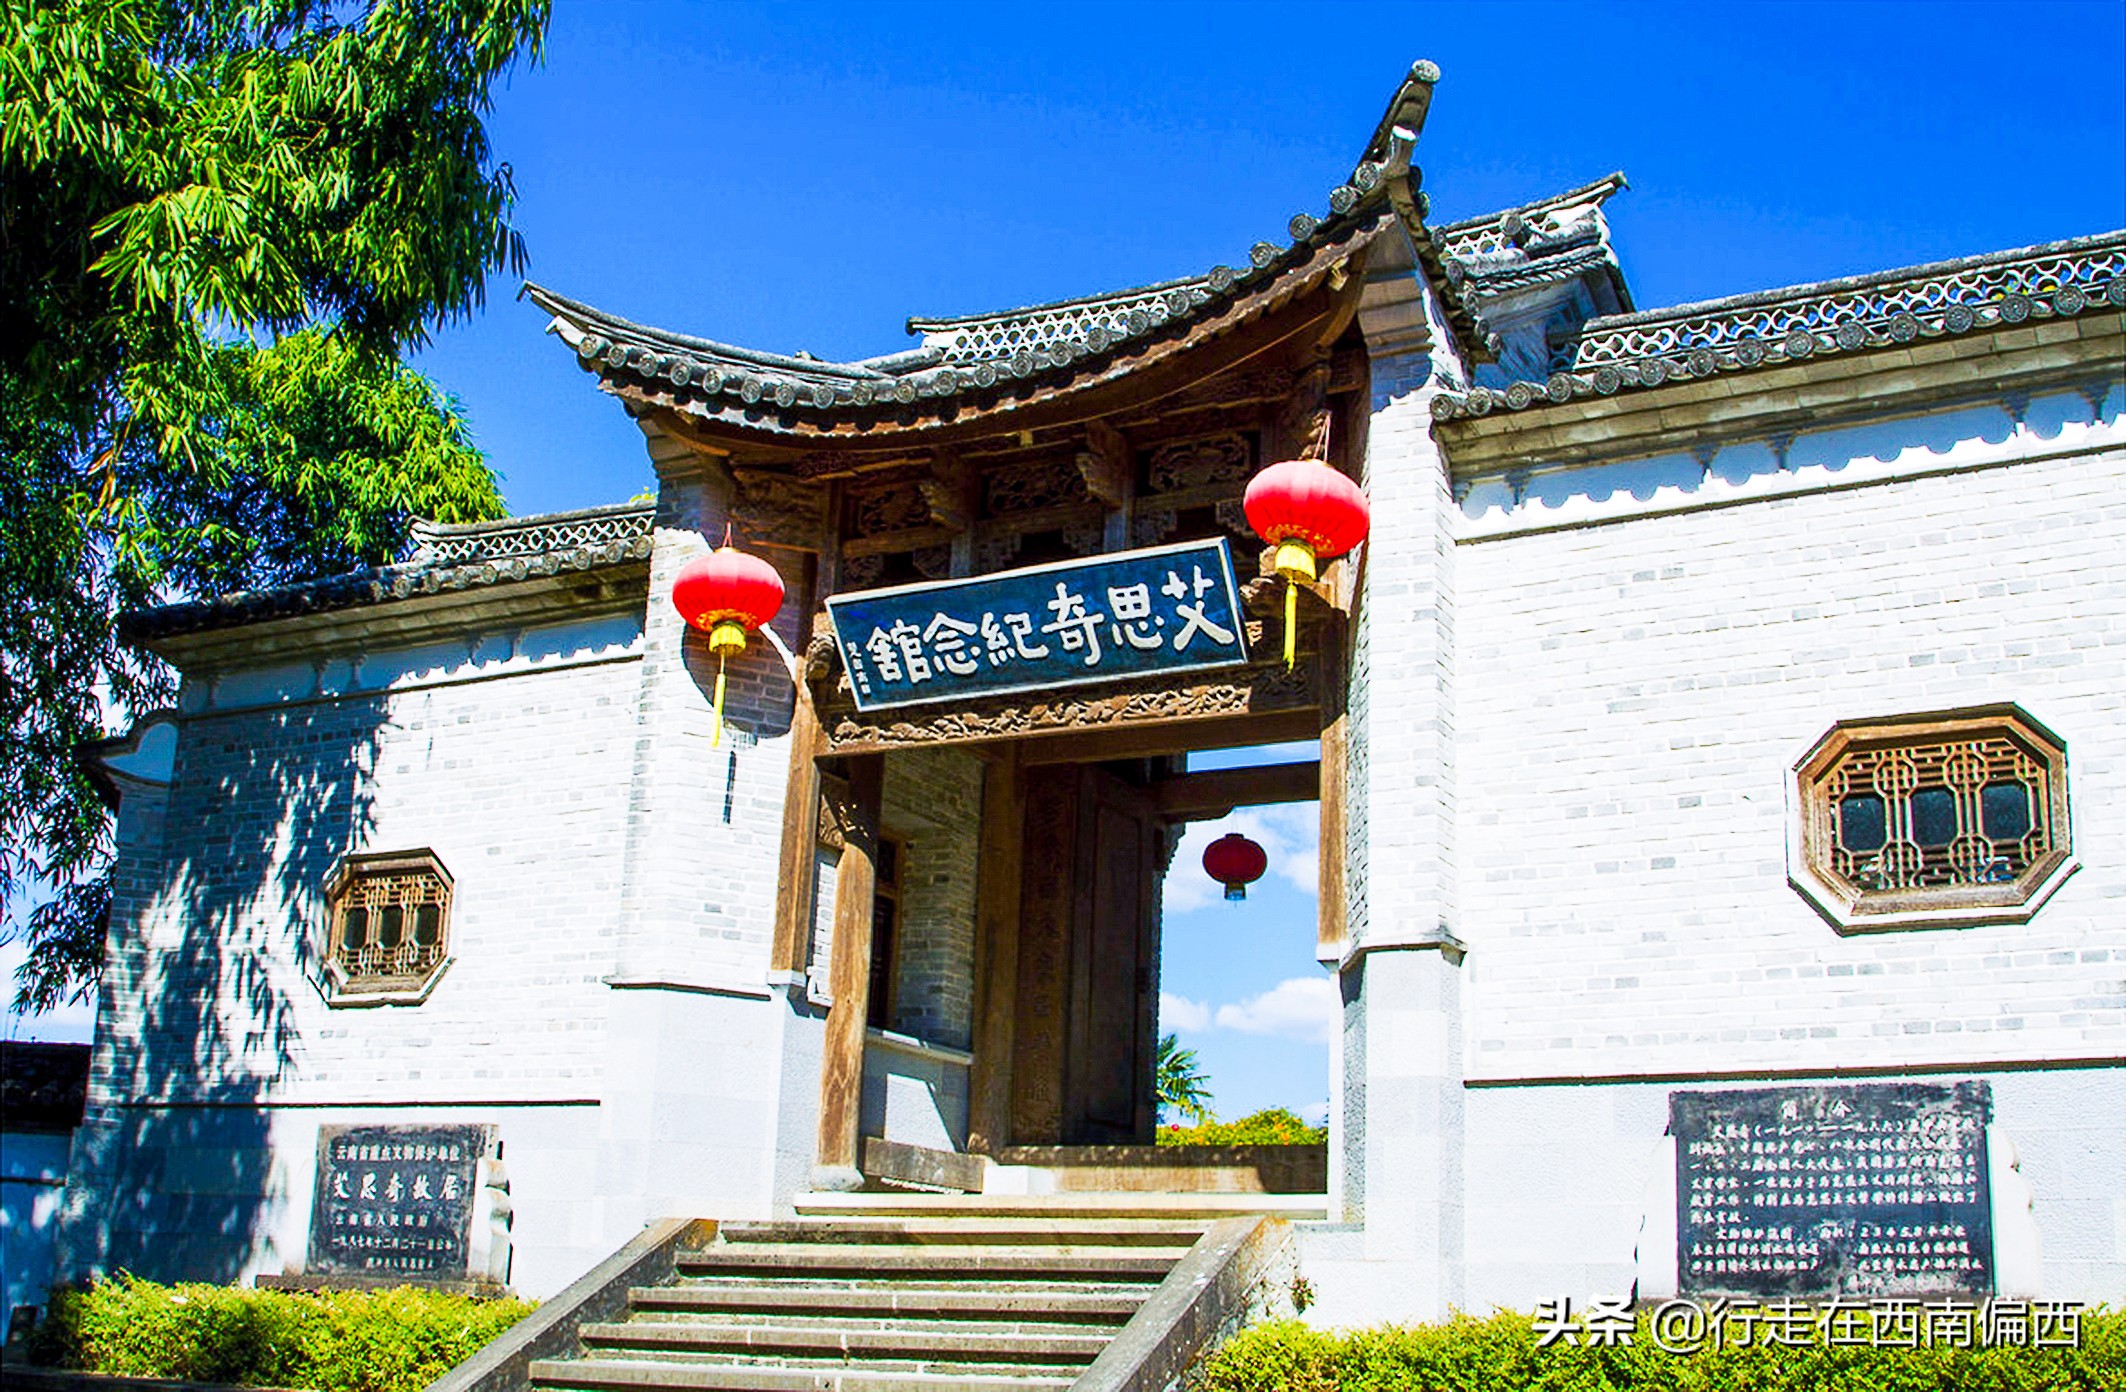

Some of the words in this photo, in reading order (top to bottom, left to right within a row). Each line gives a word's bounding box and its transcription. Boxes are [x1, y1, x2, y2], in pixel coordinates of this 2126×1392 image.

[333, 1171, 459, 1202] 艾思奇故居
